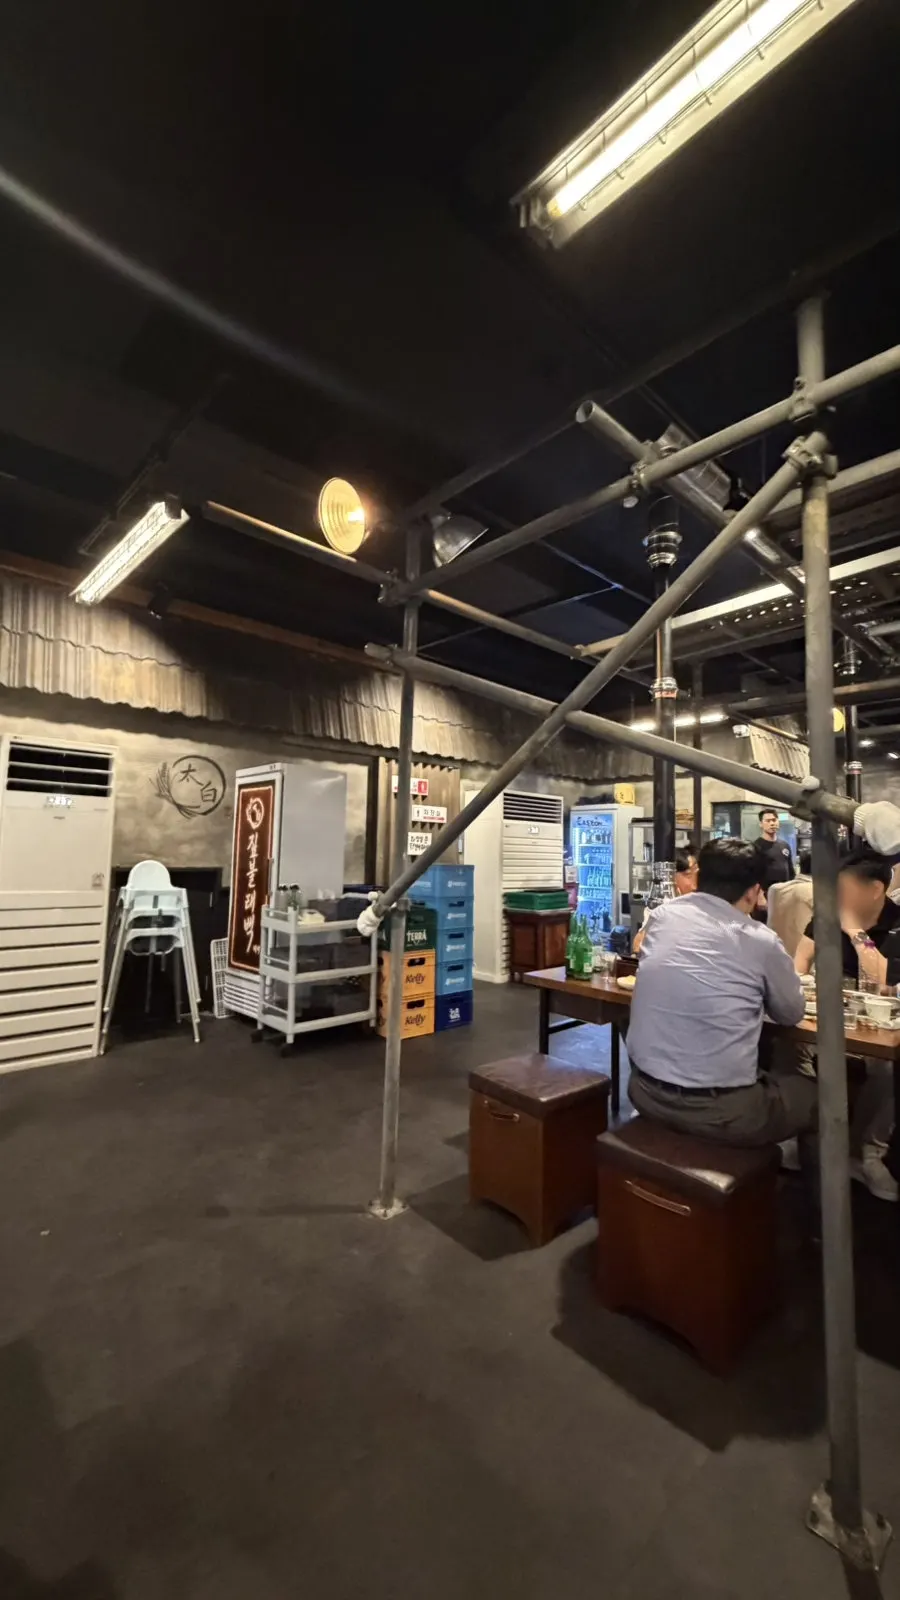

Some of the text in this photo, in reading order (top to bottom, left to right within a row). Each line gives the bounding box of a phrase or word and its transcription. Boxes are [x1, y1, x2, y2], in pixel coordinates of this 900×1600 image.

[178, 764, 218, 803] 太白
[406, 929, 428, 944] TERRA
[405, 973, 425, 985] Kelly
[404, 1013, 426, 1027] Kelly
